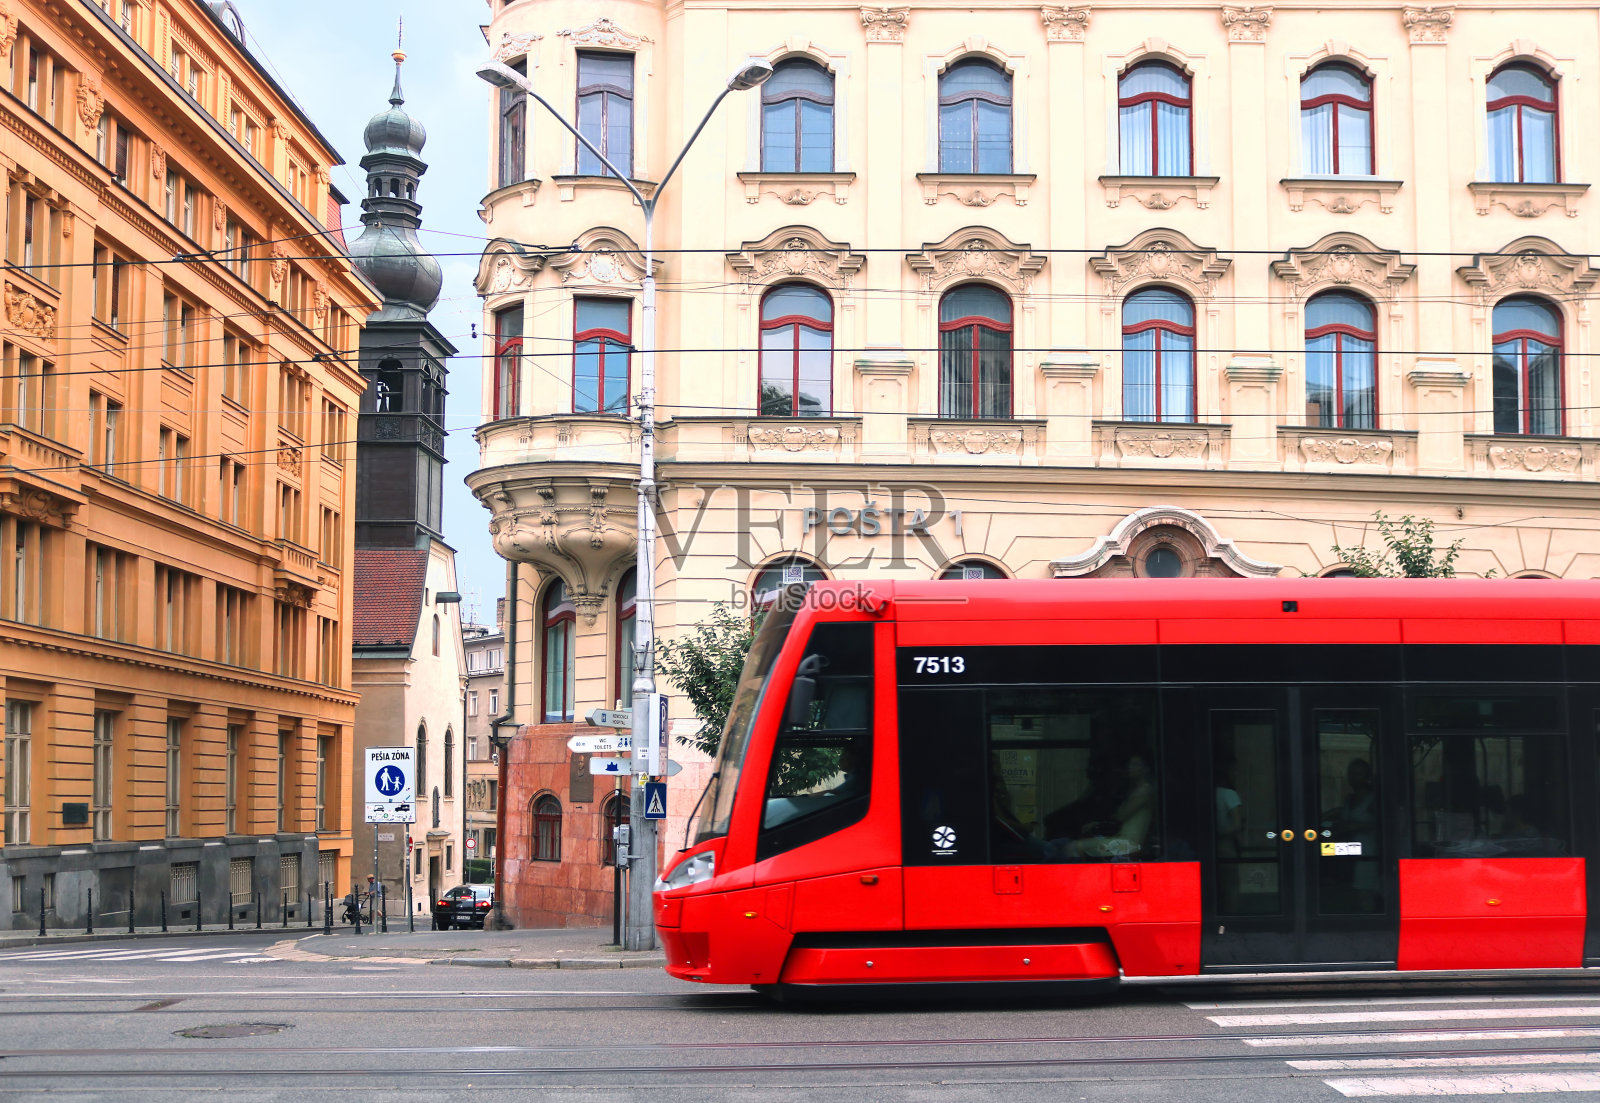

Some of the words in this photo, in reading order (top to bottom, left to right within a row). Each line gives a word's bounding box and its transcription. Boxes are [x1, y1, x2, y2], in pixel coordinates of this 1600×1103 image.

[802, 500, 930, 536] POŠTA
[949, 510, 962, 537] 1
[913, 656, 966, 674] 7513
[371, 750, 390, 761] PEŠIA
[391, 749, 410, 761] ZÓNA
